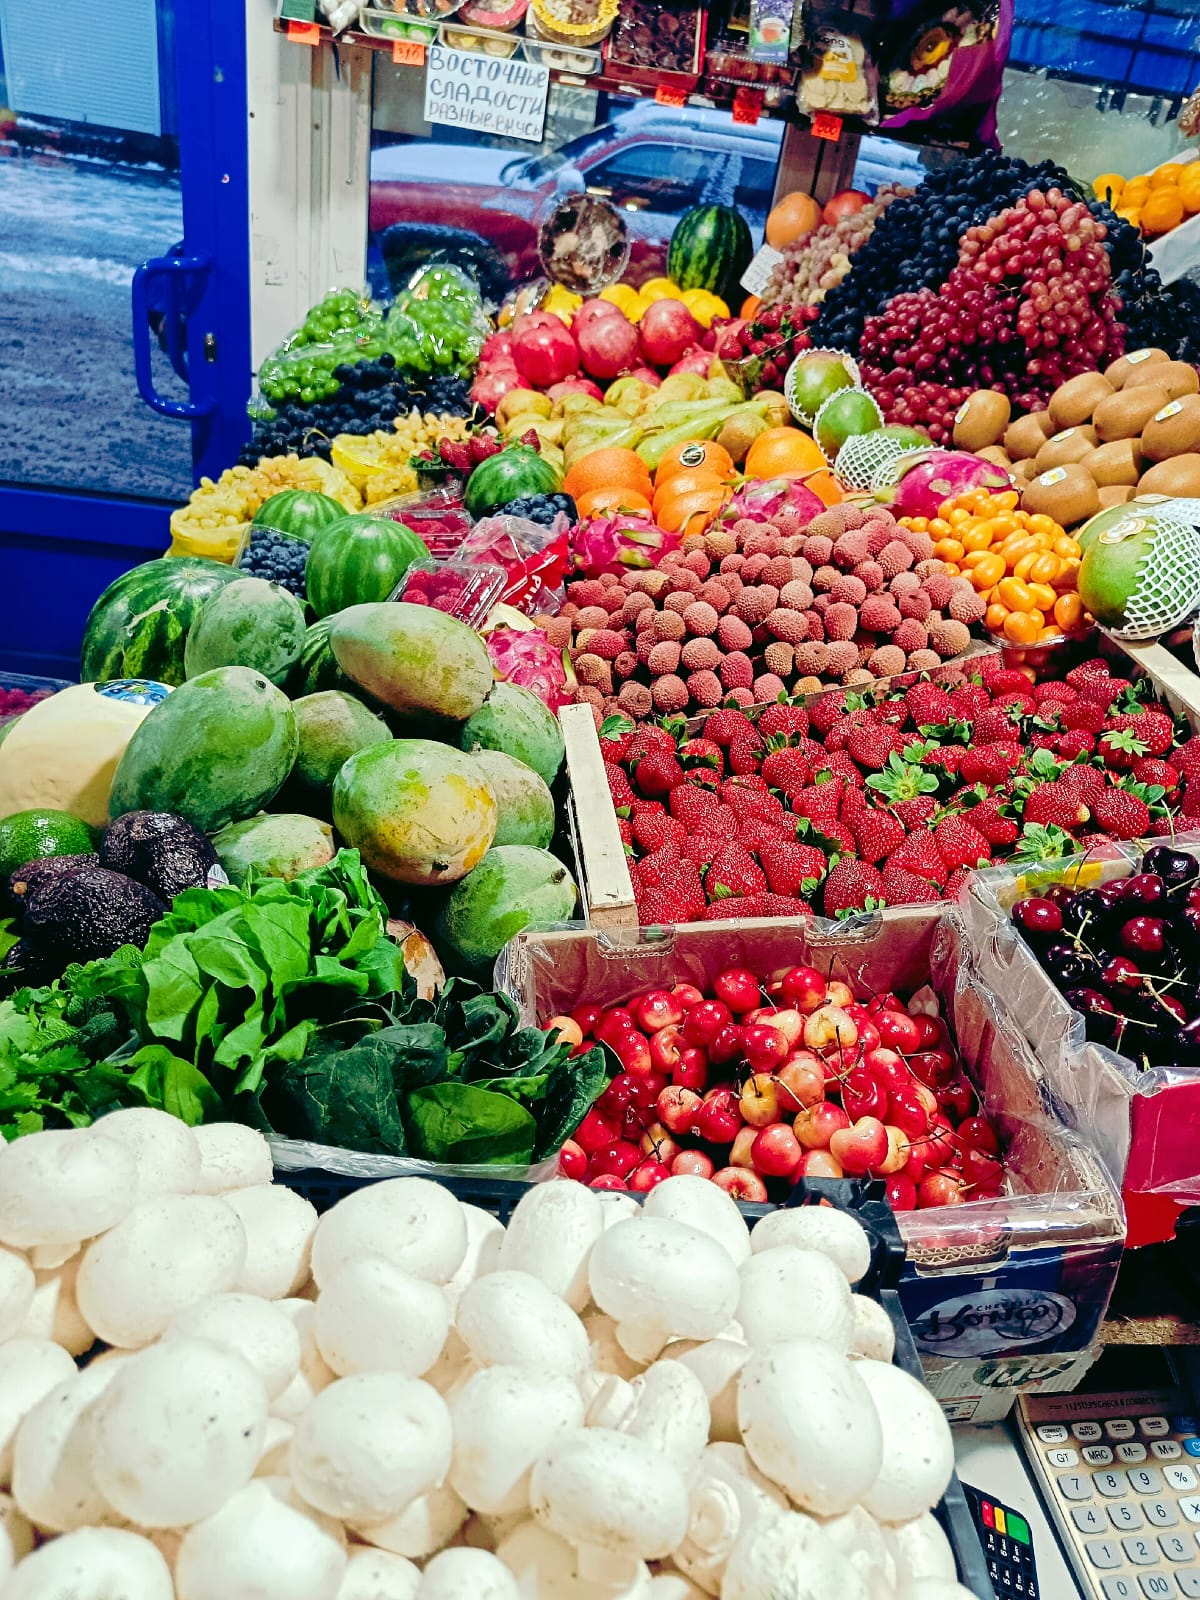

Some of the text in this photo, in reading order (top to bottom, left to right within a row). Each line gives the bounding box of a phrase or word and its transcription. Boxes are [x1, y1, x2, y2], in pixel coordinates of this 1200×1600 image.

[430, 79, 544, 116] СЛАДОСТИ
[1056, 1453, 1069, 1463] GT
[1087, 1450, 1108, 1461] MRC
[1070, 1478, 1080, 1490] 7
[1106, 1475, 1116, 1488] 8
[1139, 1472, 1150, 1485] 9
[1087, 1511, 1096, 1523] 4
[1120, 1507, 1131, 1520] 5
[1156, 1504, 1166, 1518] 6
[1101, 1546, 1111, 1558] 1
[1136, 1542, 1148, 1556] 2
[1172, 1539, 1183, 1552] 3
[1117, 1581, 1127, 1596] 0
[1150, 1577, 1168, 1593] 00
